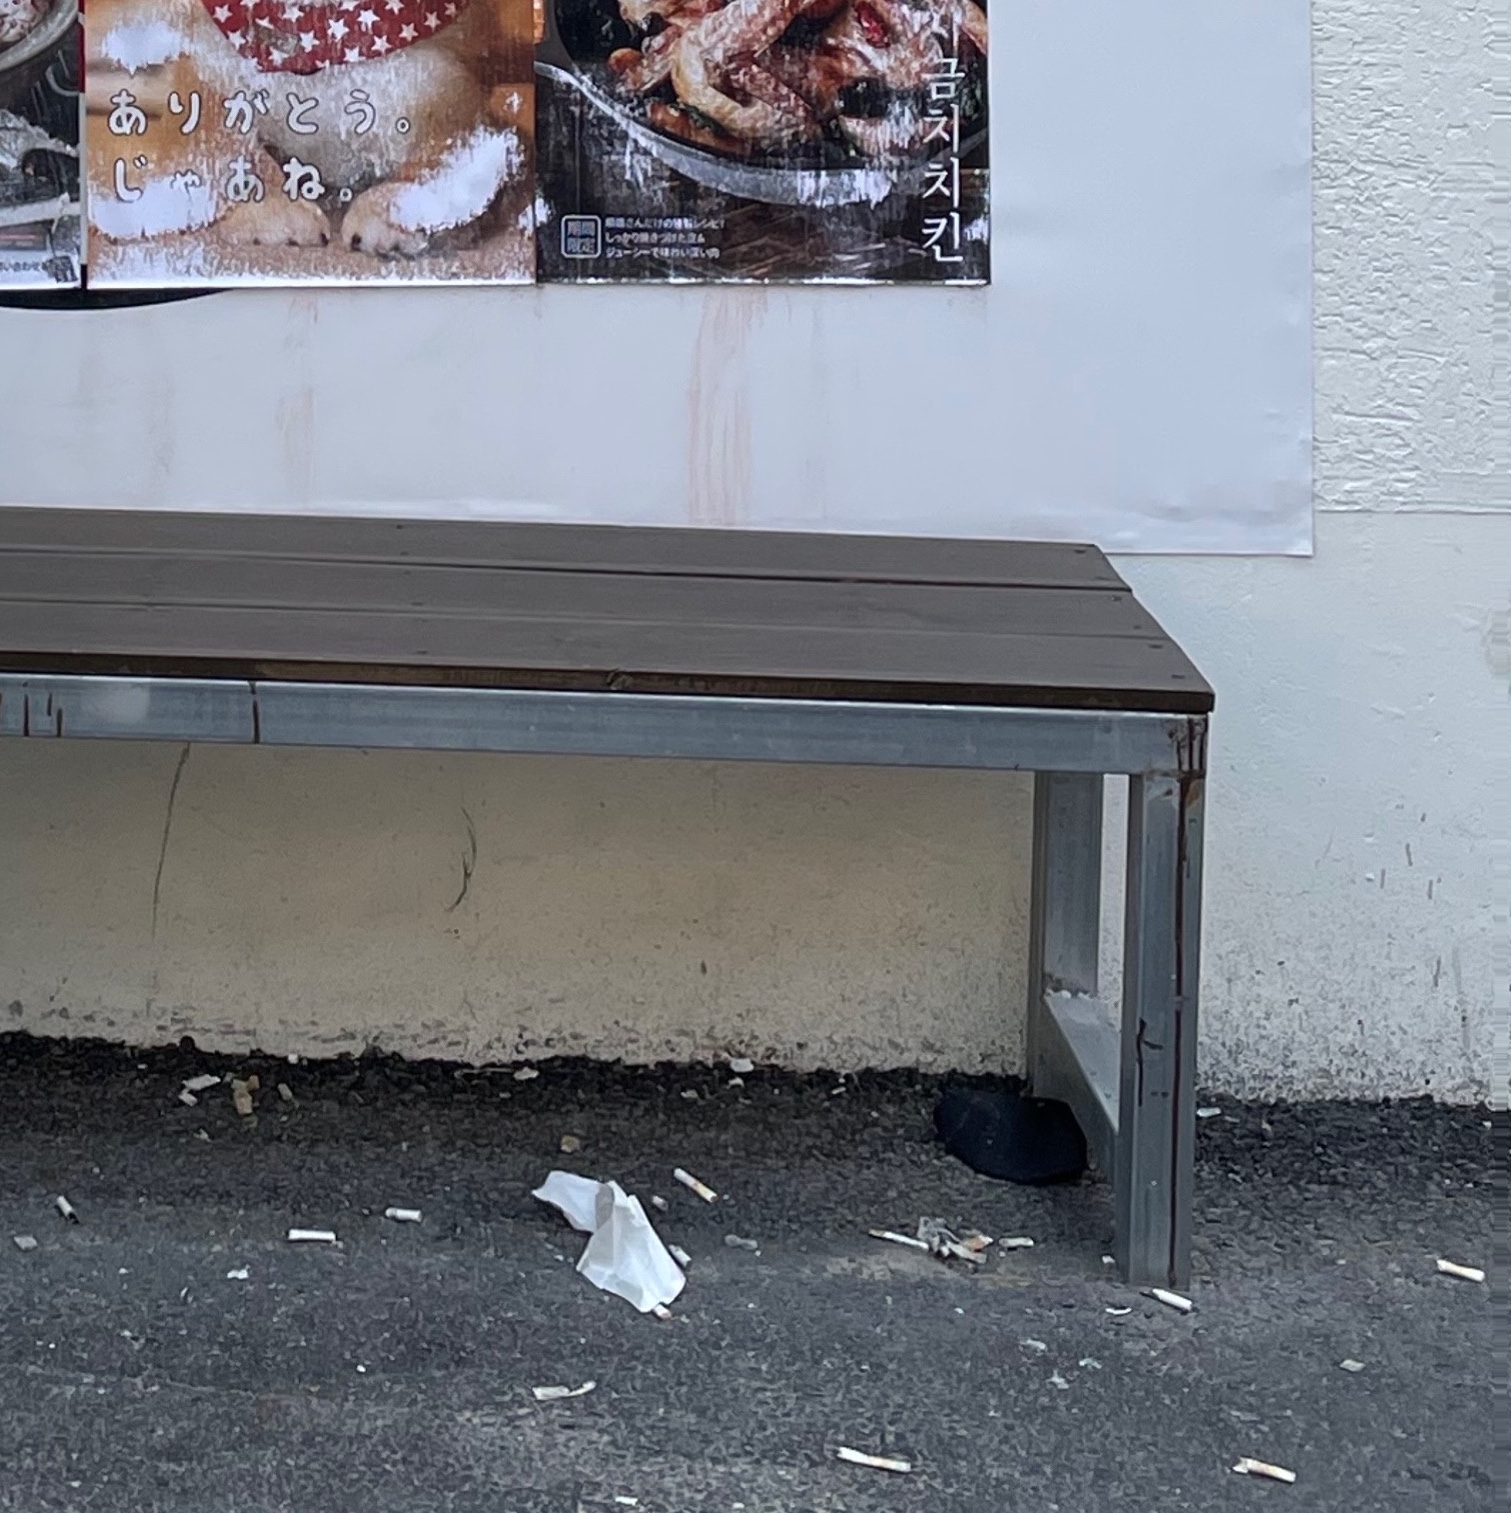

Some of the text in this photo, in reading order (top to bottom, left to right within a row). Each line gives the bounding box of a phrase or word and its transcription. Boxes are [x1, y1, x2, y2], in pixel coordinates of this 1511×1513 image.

[107, 88, 411, 136] ありがとう。
[113, 156, 354, 203] じゃあね。
